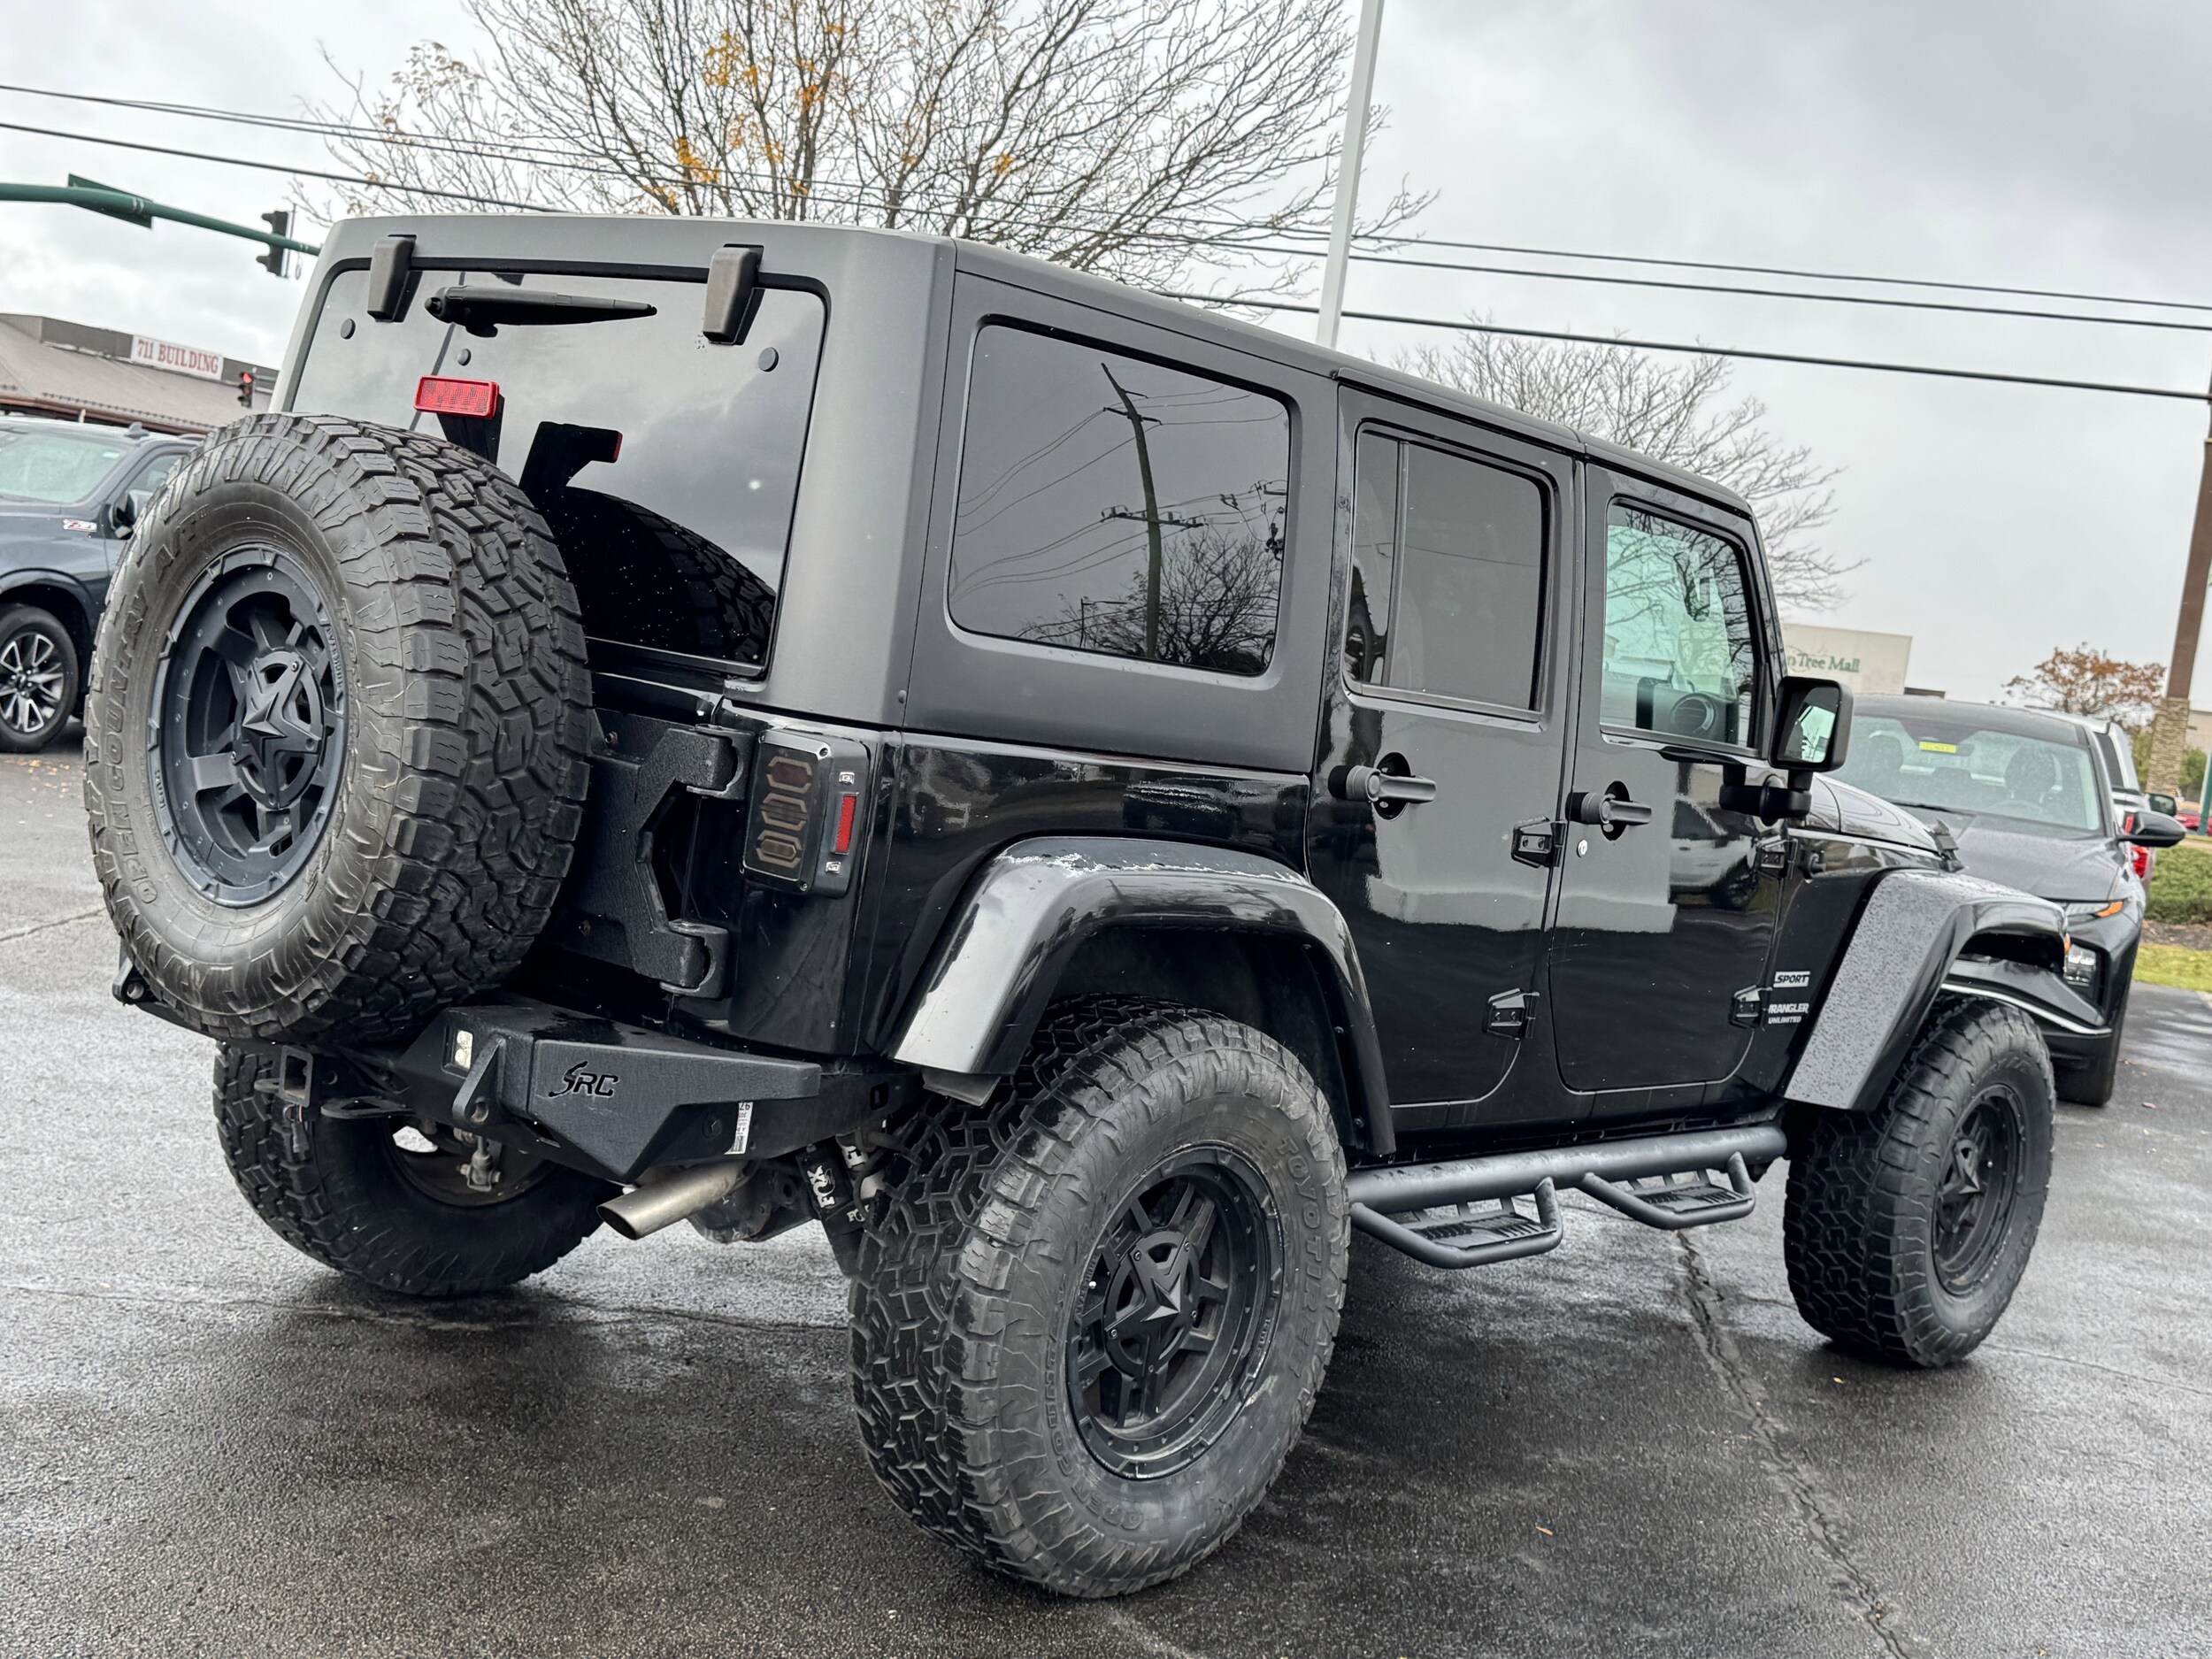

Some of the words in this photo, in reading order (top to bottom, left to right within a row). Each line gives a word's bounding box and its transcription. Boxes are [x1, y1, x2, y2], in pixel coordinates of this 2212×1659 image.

[137, 339, 154, 360] 711
[157, 344, 219, 374] BUILDING
[1798, 653, 1826, 669] Tree
[1830, 656, 1860, 673] Mall
[104, 580, 149, 792] COUNTRY
[1776, 973, 1809, 984] SPORT
[1768, 1016, 1802, 1025] UNLIMITED
[549, 1060, 619, 1098] SRC
[806, 1164, 836, 1209] FOX
[1275, 1134, 1321, 1230] TOYO
